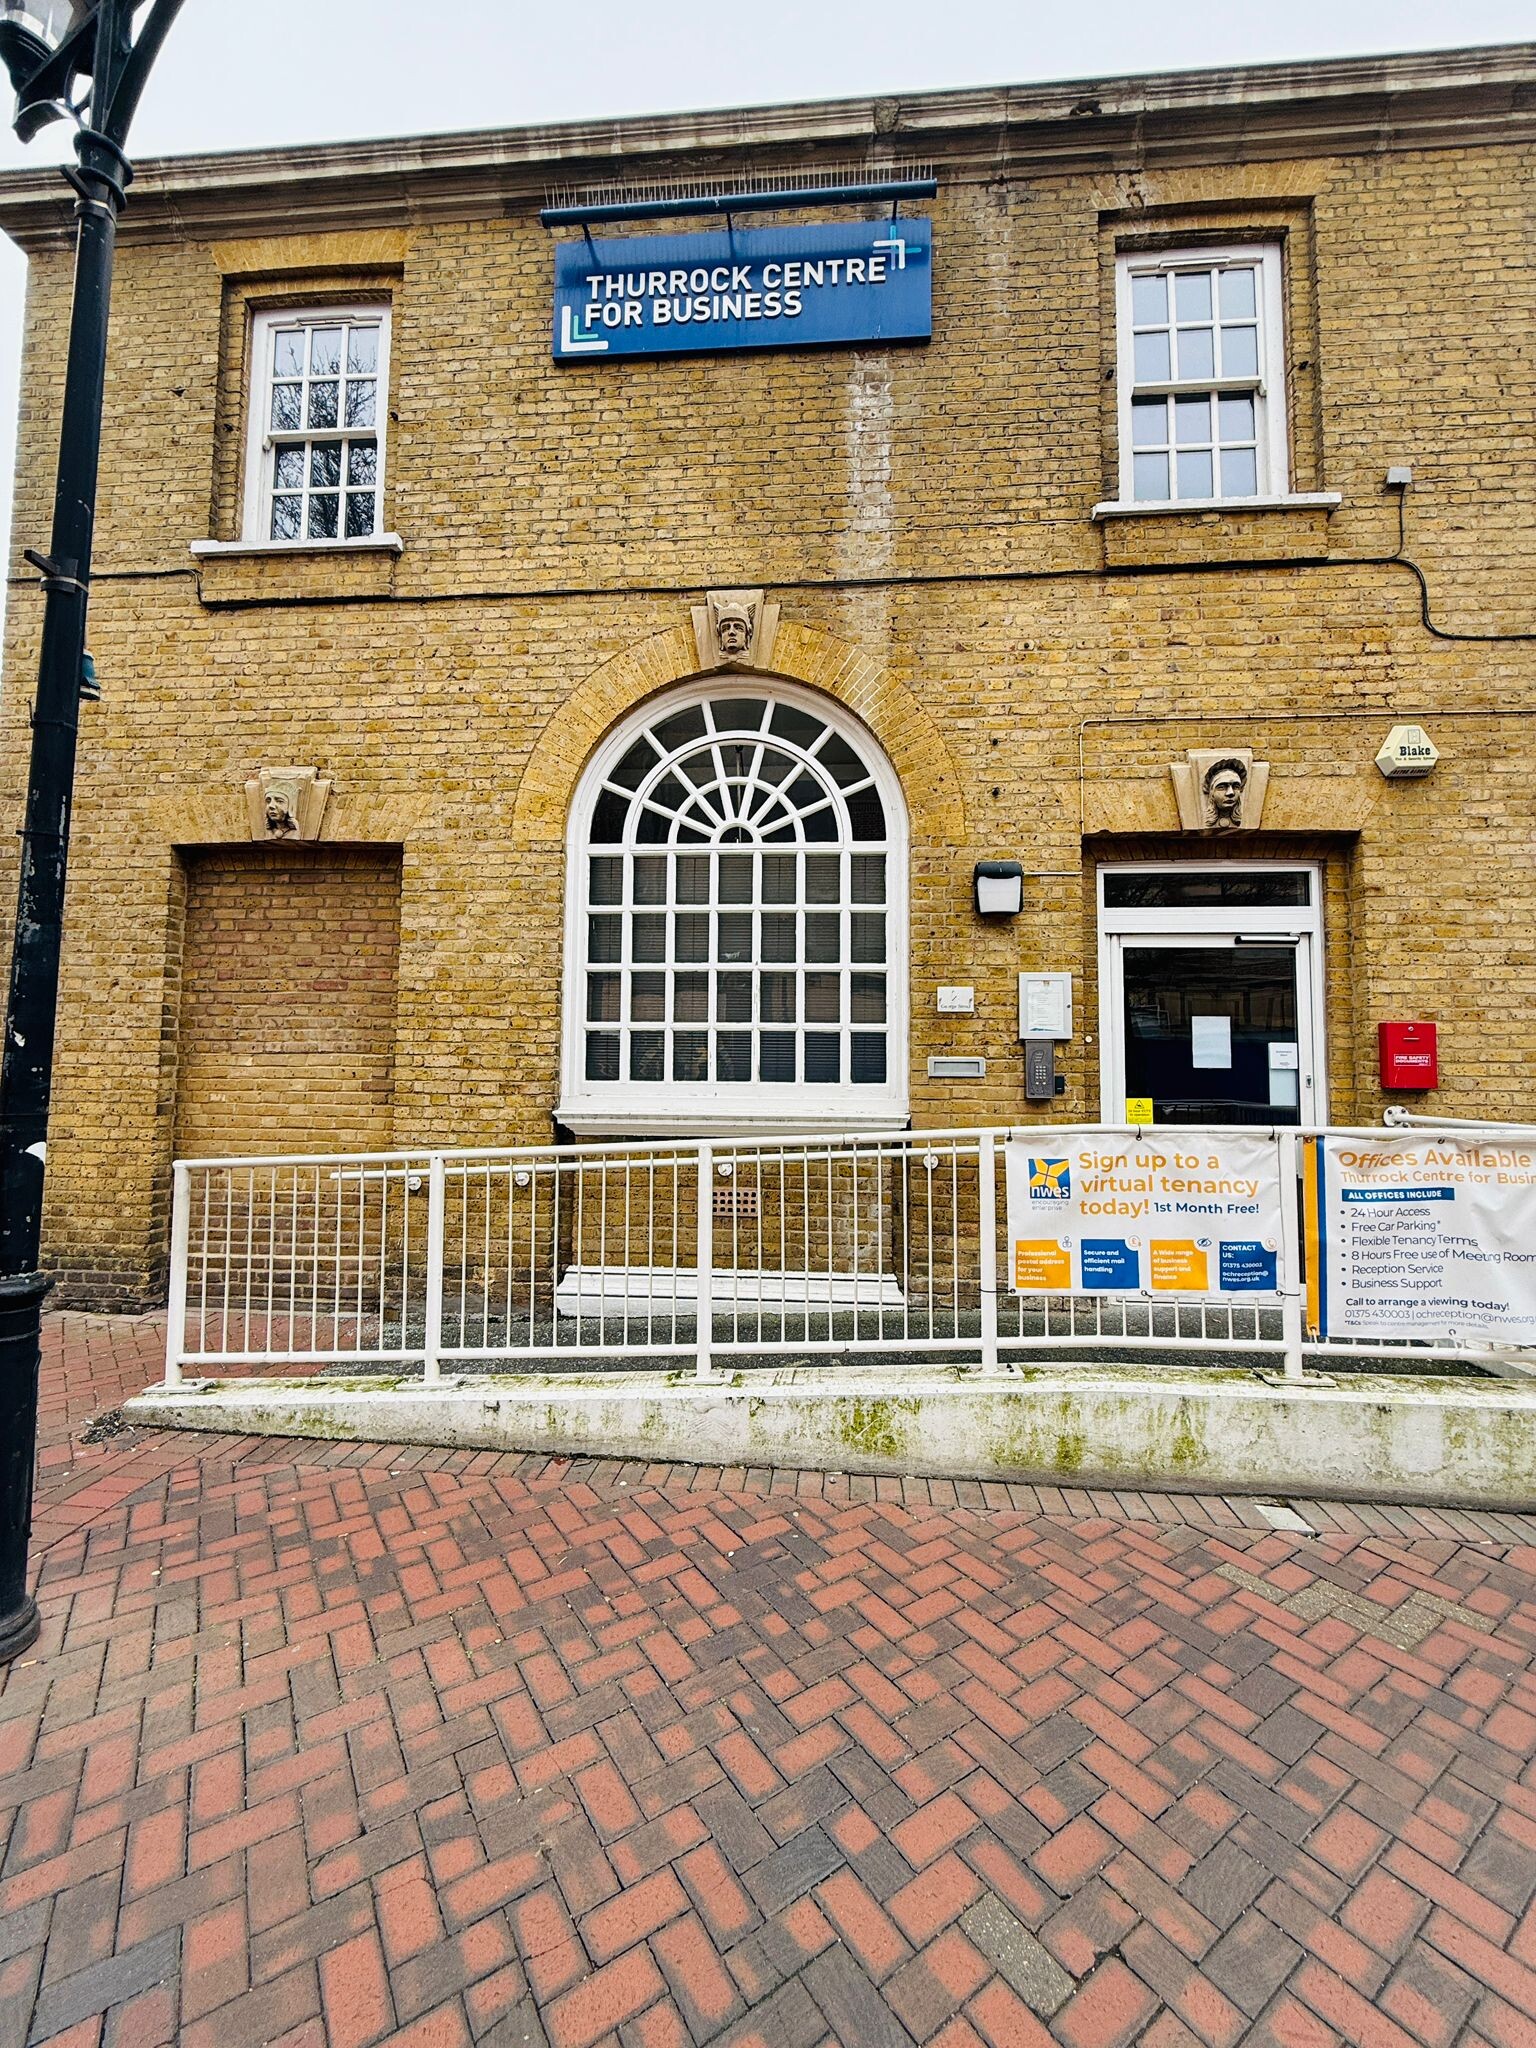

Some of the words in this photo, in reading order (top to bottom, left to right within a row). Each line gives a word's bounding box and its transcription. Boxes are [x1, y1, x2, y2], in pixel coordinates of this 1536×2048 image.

[586, 265, 752, 300] THURROCK
[762, 256, 886, 289] CENTRE
[584, 301, 643, 329] FOR
[653, 290, 803, 325] BUSINESS
[1399, 745, 1431, 756] Blake
[1079, 1151, 1128, 1173] Sign
[1135, 1154, 1167, 1172] up
[1174, 1153, 1199, 1169] to
[1207, 1155, 1219, 1169] a
[1338, 1152, 1418, 1168] Offices
[1424, 1149, 1531, 1167] Available
[1341, 1170, 1408, 1183] Thurrock
[1412, 1170, 1465, 1182] Centre
[1468, 1171, 1490, 1183] for
[1031, 1186, 1069, 1198] nwes
[1080, 1175, 1153, 1193] virtual
[1160, 1176, 1259, 1198] tenancy
[1348, 1191, 1364, 1199] ALL
[1364, 1191, 1404, 1199] OFFICES
[1406, 1190, 1442, 1198] INCLUDE
[1079, 1198, 1149, 1219] today!
[1154, 1202, 1172, 1212] 1st
[1176, 1202, 1223, 1214] Month
[1227, 1203, 1260, 1214] Free!
[1350, 1207, 1366, 1217] 24
[1367, 1208, 1394, 1218] Hour
[1395, 1207, 1431, 1217] Access
[1351, 1222, 1376, 1232] Free
[1378, 1222, 1395, 1232] Car
[1352, 1236, 1390, 1246] Flexible
[1392, 1235, 1436, 1246] Tenancy
[1437, 1234, 1479, 1247] Terms
[1351, 1250, 1360, 1260] 8
[1361, 1250, 1392, 1260] Hours
[1393, 1249, 1419, 1259] Free
[1420, 1251, 1438, 1259] use
[1439, 1248, 1450, 1258] of
[1084, 1266, 1113, 1274] handling
[1352, 1264, 1405, 1275] Reception
[1408, 1263, 1444, 1274] Service
[1352, 1278, 1399, 1289] Business
[1400, 1278, 1443, 1290] Support
[1345, 1298, 1364, 1306] Call
[1365, 1298, 1376, 1306] to
[1377, 1299, 1419, 1308] arrange
[1428, 1296, 1469, 1308] viewing
[1471, 1299, 1510, 1312] today!
[1344, 1309, 1371, 1318] 01375
[1372, 1309, 1411, 1318] 430003
